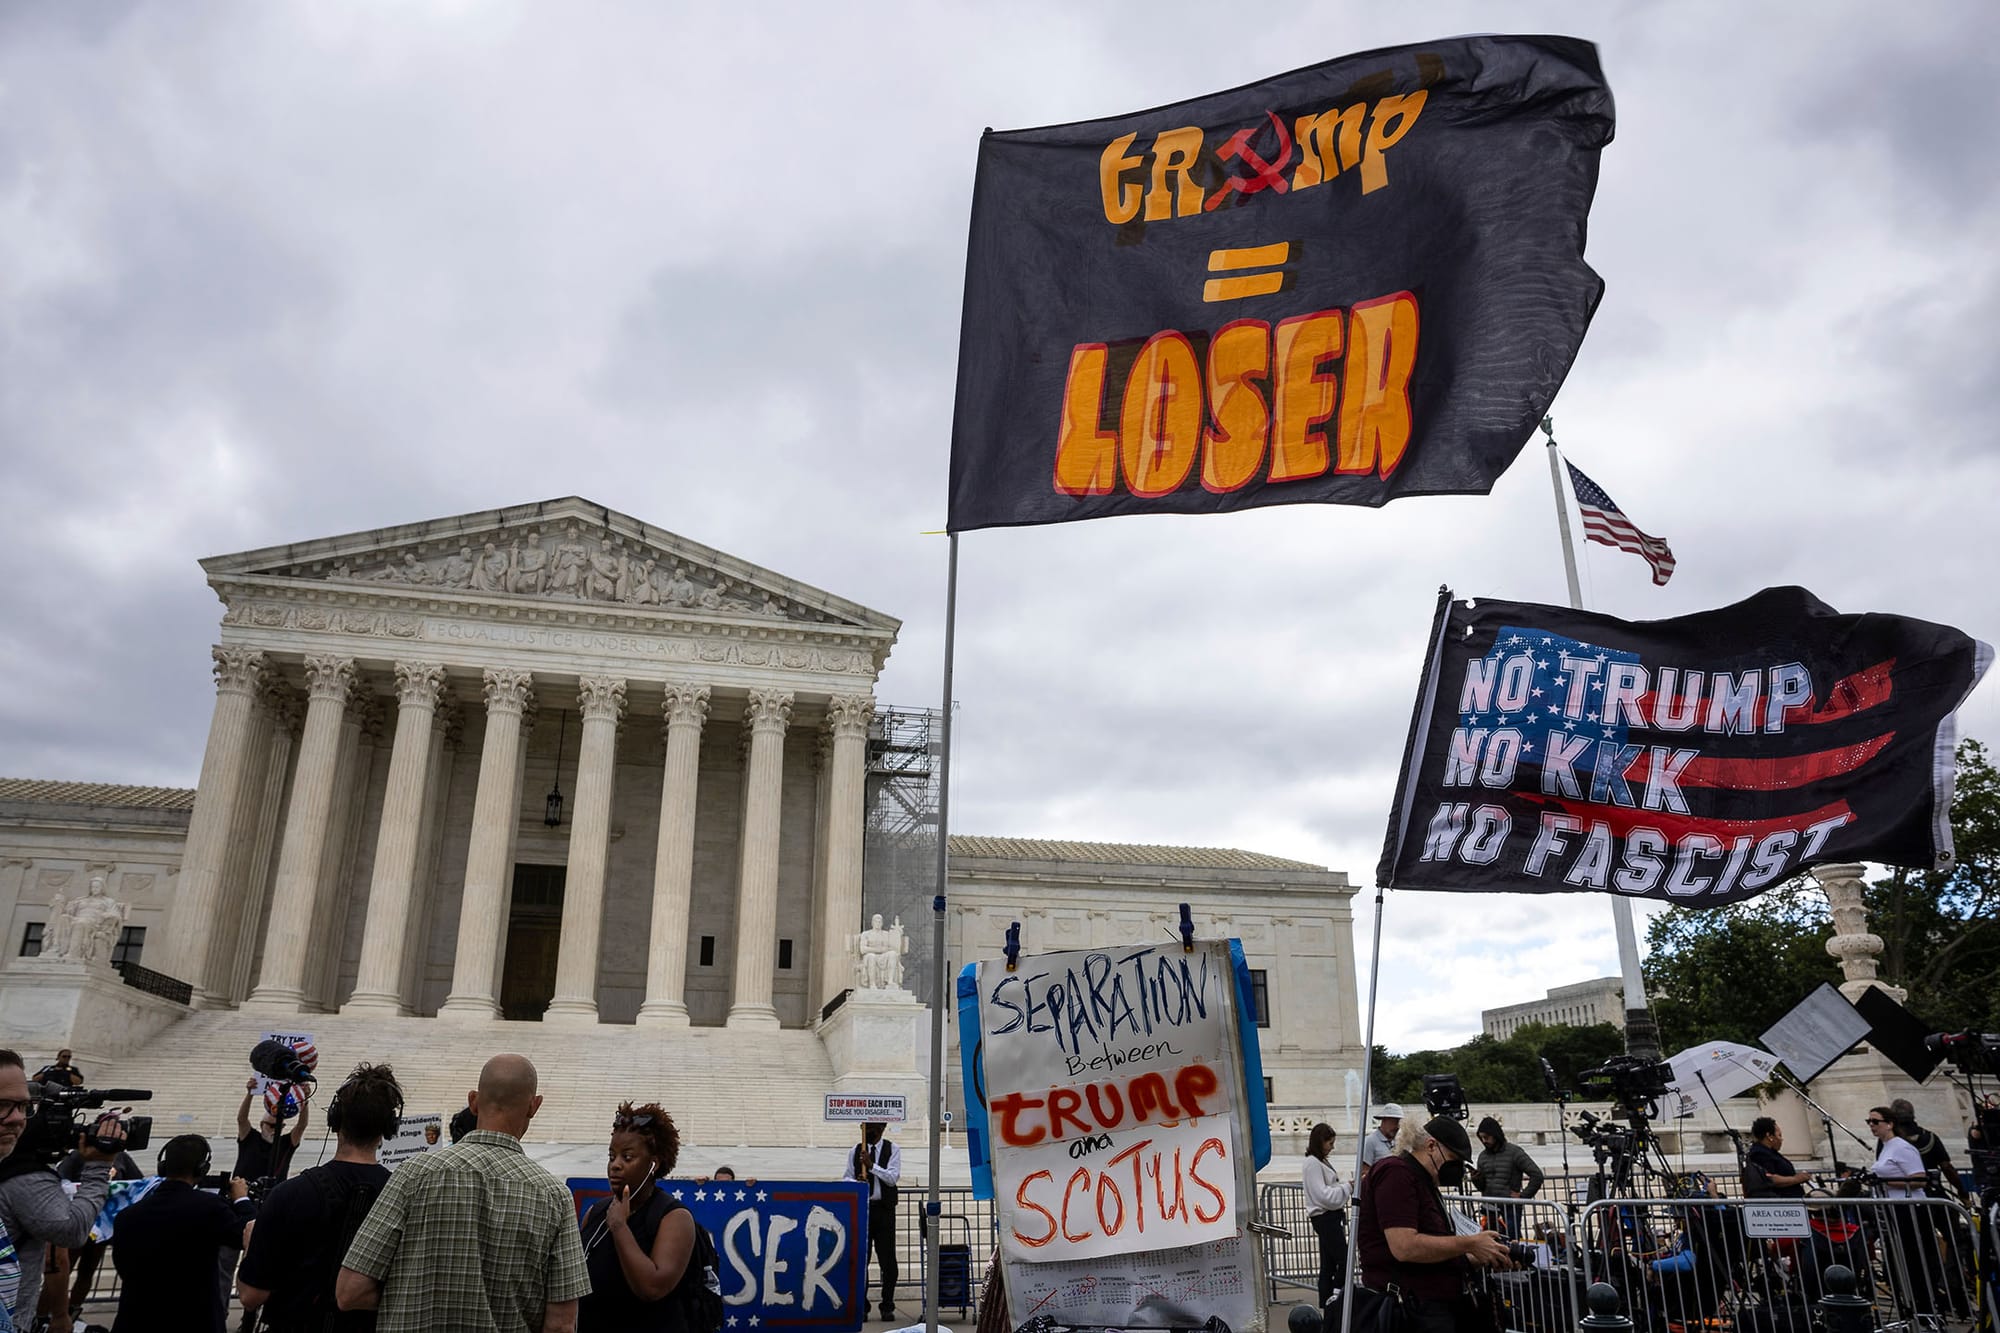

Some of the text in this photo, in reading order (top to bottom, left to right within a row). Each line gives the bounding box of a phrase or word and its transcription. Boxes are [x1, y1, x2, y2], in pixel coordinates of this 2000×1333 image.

[1053, 290, 1420, 498] LOSER
[437, 624, 681, 656] EQUAL JUSTICE UNDER LAW
[1459, 654, 1816, 737] NO TRUMP
[1443, 727, 1704, 814] NO KKK
[1419, 802, 1854, 897] NO FASCIST
[988, 948, 1207, 1055] SEPARATION
[1065, 1040, 1183, 1077] Between
[829, 1099, 902, 1108] STOP HATING EACH OTHER
[829, 1108, 853, 1116] BECAUSE
[1069, 1133, 1115, 1160] and
[1012, 1137, 1226, 1248] SCOTUS
[709, 1205, 846, 1311] SER
